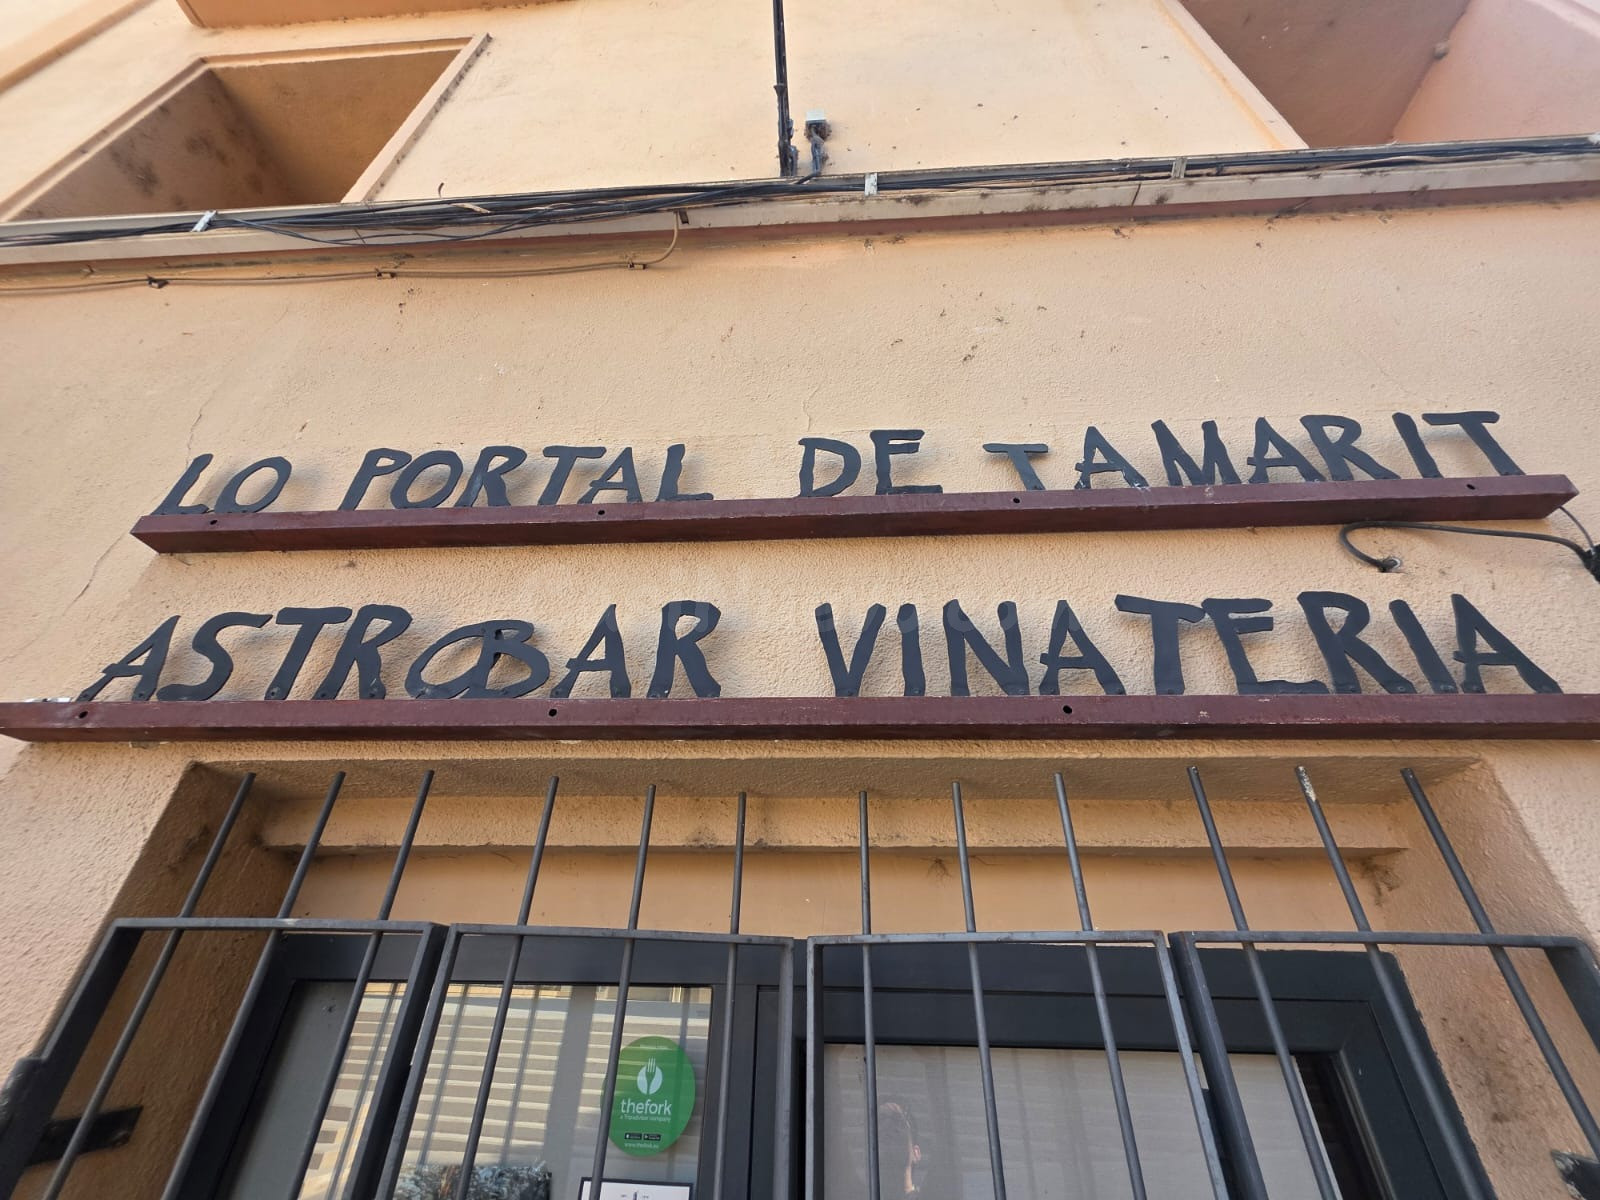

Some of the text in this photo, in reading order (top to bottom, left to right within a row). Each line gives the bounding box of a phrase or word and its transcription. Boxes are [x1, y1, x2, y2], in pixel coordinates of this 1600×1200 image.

[153, 411, 1527, 514] LO PORTAL DE TAMARIT
[77, 591, 1563, 702] ASTROBAR VINATERIA
[621, 1098, 672, 1116] thefork
